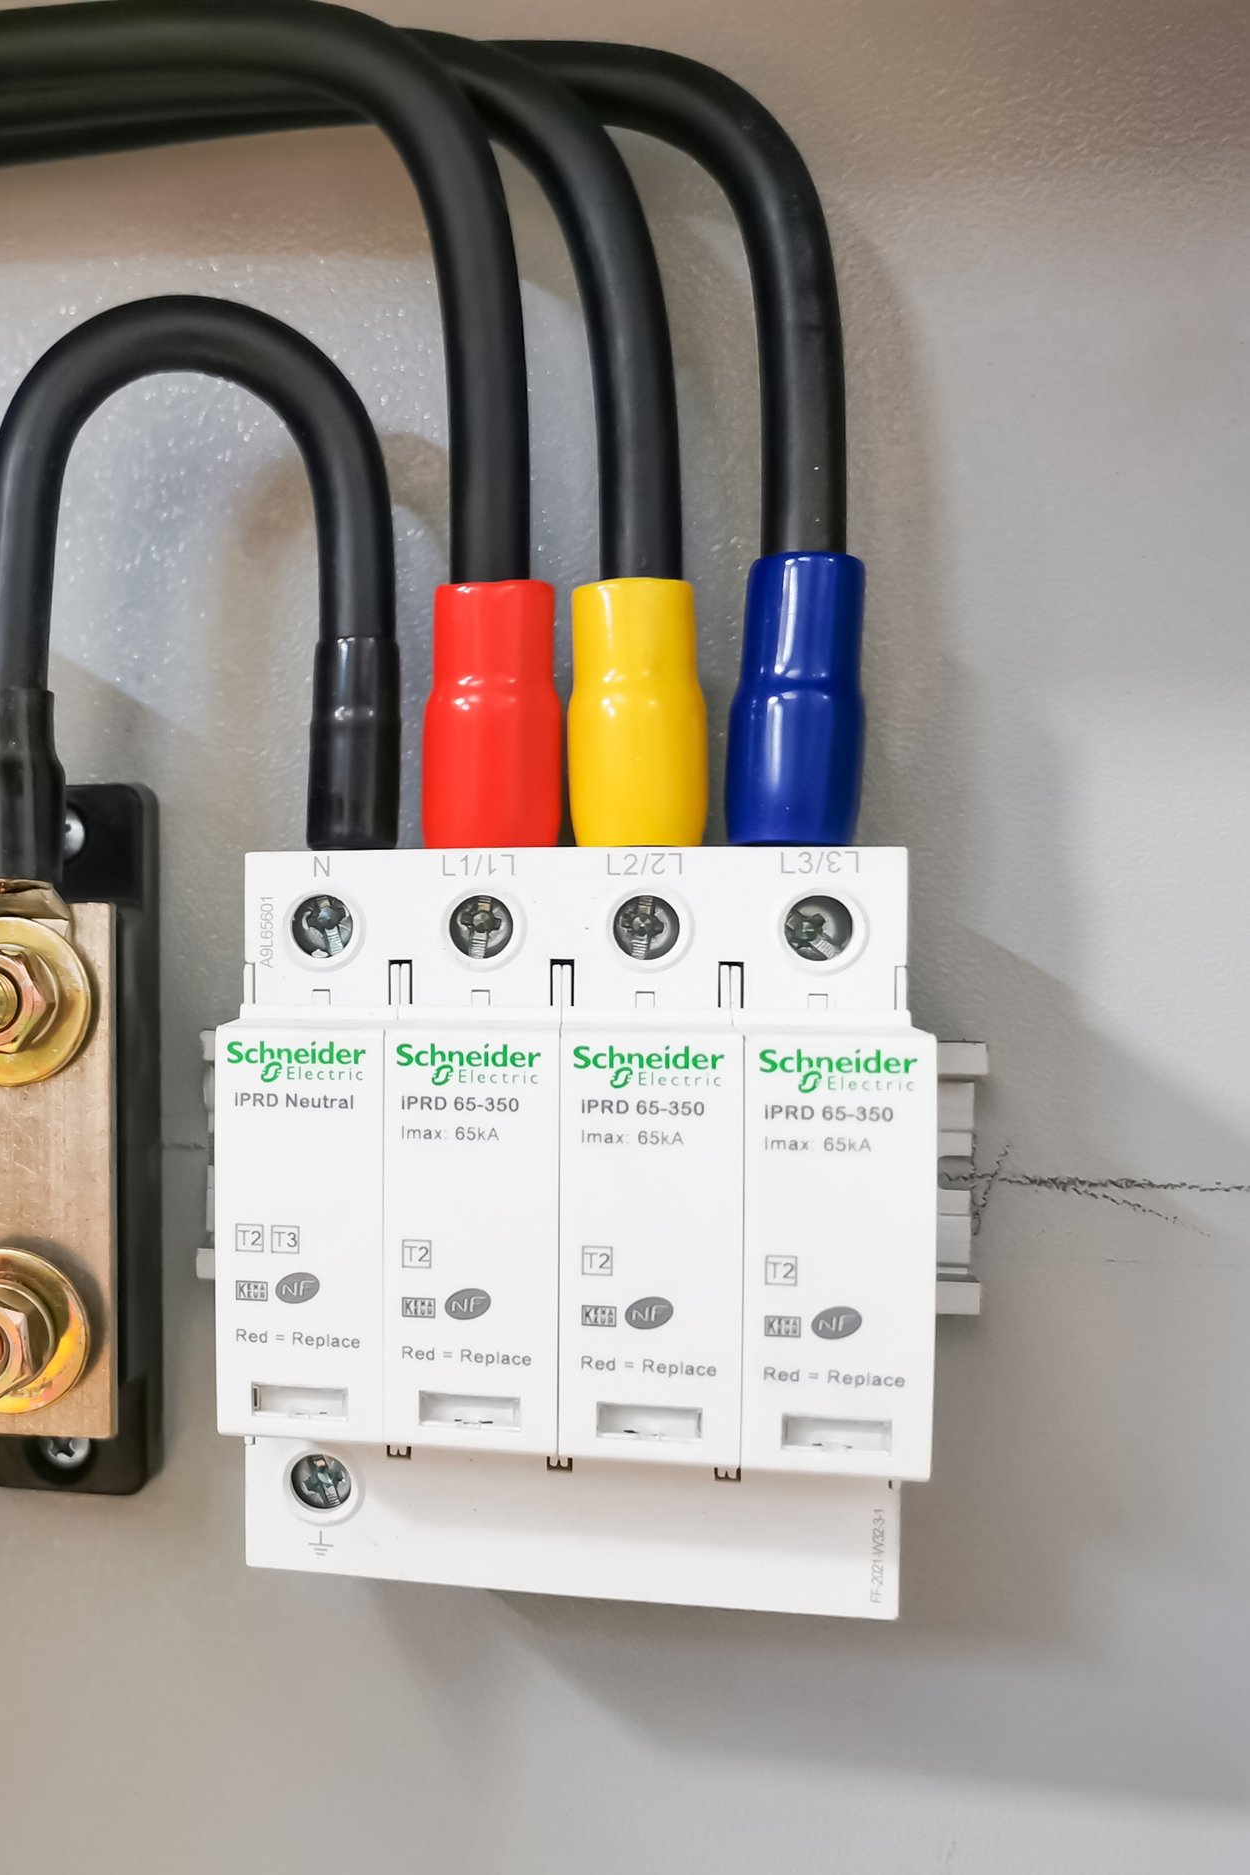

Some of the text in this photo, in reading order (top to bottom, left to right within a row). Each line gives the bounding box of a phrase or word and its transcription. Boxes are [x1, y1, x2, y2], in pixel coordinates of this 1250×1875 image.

[313, 855, 332, 878] N
[260, 897, 274, 969] A9L65601
[226, 1040, 366, 1066] Schneider
[396, 1043, 541, 1069] Schneider
[573, 1045, 725, 1070] Schneider
[759, 1048, 918, 1075] Schneider
[286, 1066, 364, 1082] Electric
[459, 1069, 539, 1085] Electric
[638, 1071, 722, 1088] Electric
[828, 1075, 916, 1093] Electric
[234, 1092, 354, 1110] iPRD Neutral
[401, 1095, 519, 1113] iPRD 65-350
[581, 1099, 705, 1117] iPRD 65-350
[764, 1104, 894, 1123] iPRD 65-350
[455, 1126, 499, 1142] 65kA
[637, 1130, 684, 1146] 65kA
[823, 1136, 872, 1152] 65kA
[237, 1229, 298, 1248] T2 T3
[405, 1245, 430, 1263] T2
[585, 1252, 610, 1270] T2
[768, 1262, 795, 1280] T2
[282, 1280, 316, 1296] NF
[451, 1296, 486, 1313] NF
[632, 1305, 668, 1322] NF
[819, 1314, 855, 1332] NF
[236, 1329, 268, 1344] Red
[292, 1331, 361, 1350] Replace
[402, 1346, 435, 1362] Red
[460, 1349, 532, 1367] Replace
[581, 1356, 616, 1372] Red
[642, 1359, 717, 1378] Replace
[764, 1367, 800, 1382] Red
[827, 1370, 906, 1388] Replace
